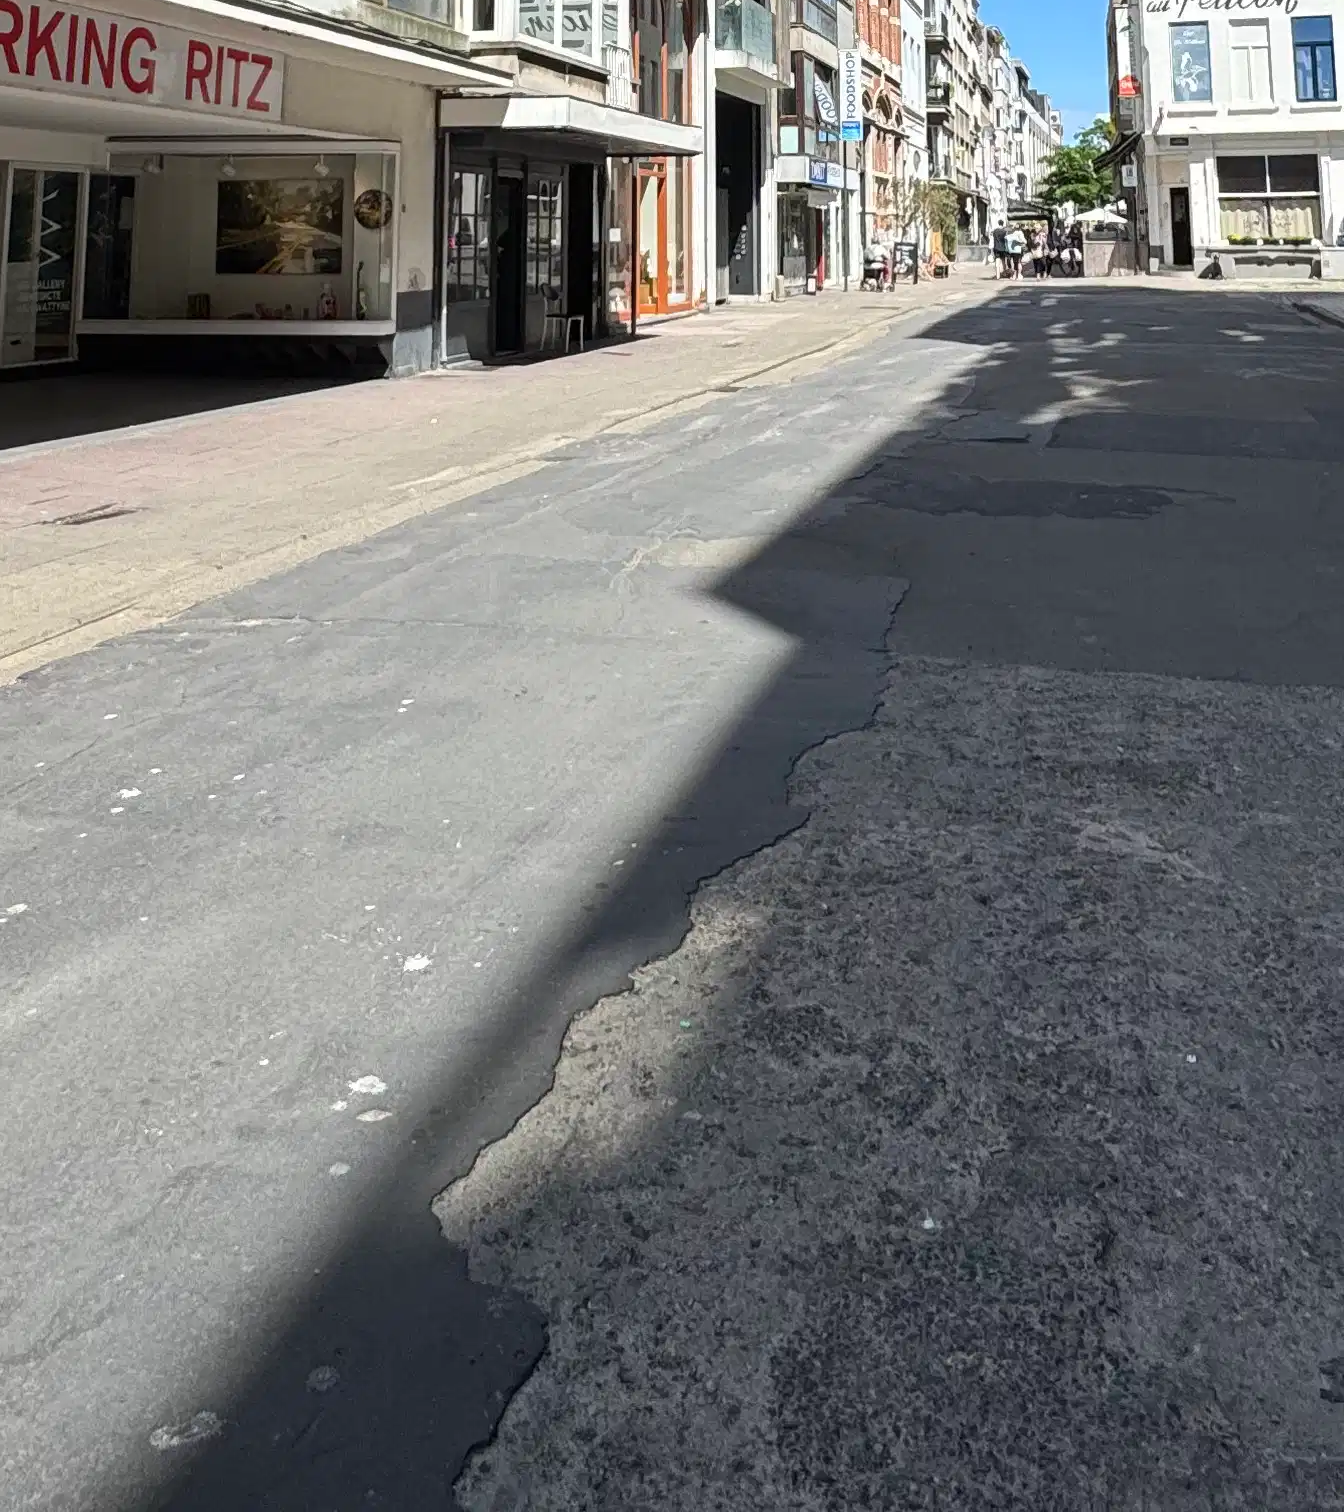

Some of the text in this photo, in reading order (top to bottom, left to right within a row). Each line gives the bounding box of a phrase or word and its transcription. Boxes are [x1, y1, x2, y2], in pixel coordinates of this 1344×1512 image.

[1146, 0, 1171, 13] au
[185, 39, 273, 112] RITZ
[845, 51, 857, 120] FOODSHOP
